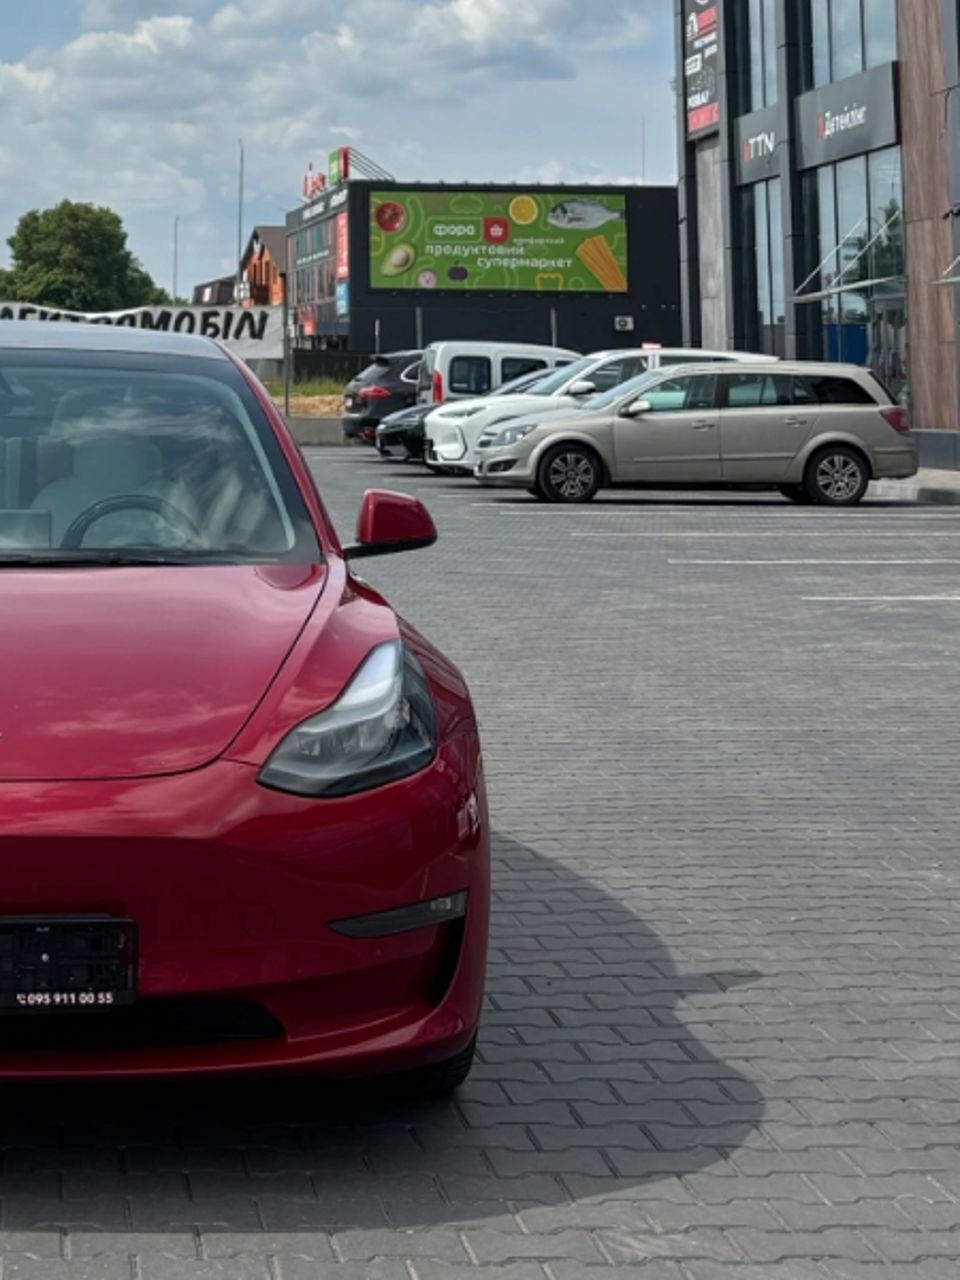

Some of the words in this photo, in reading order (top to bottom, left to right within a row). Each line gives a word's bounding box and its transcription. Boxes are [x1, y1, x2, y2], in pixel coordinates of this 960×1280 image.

[477, 256, 573, 269] супермаркет
[27, 993, 52, 1005] 095
[52, 993, 76, 1005] 911
[79, 992, 95, 1005] 00
[97, 991, 114, 1005] 55
